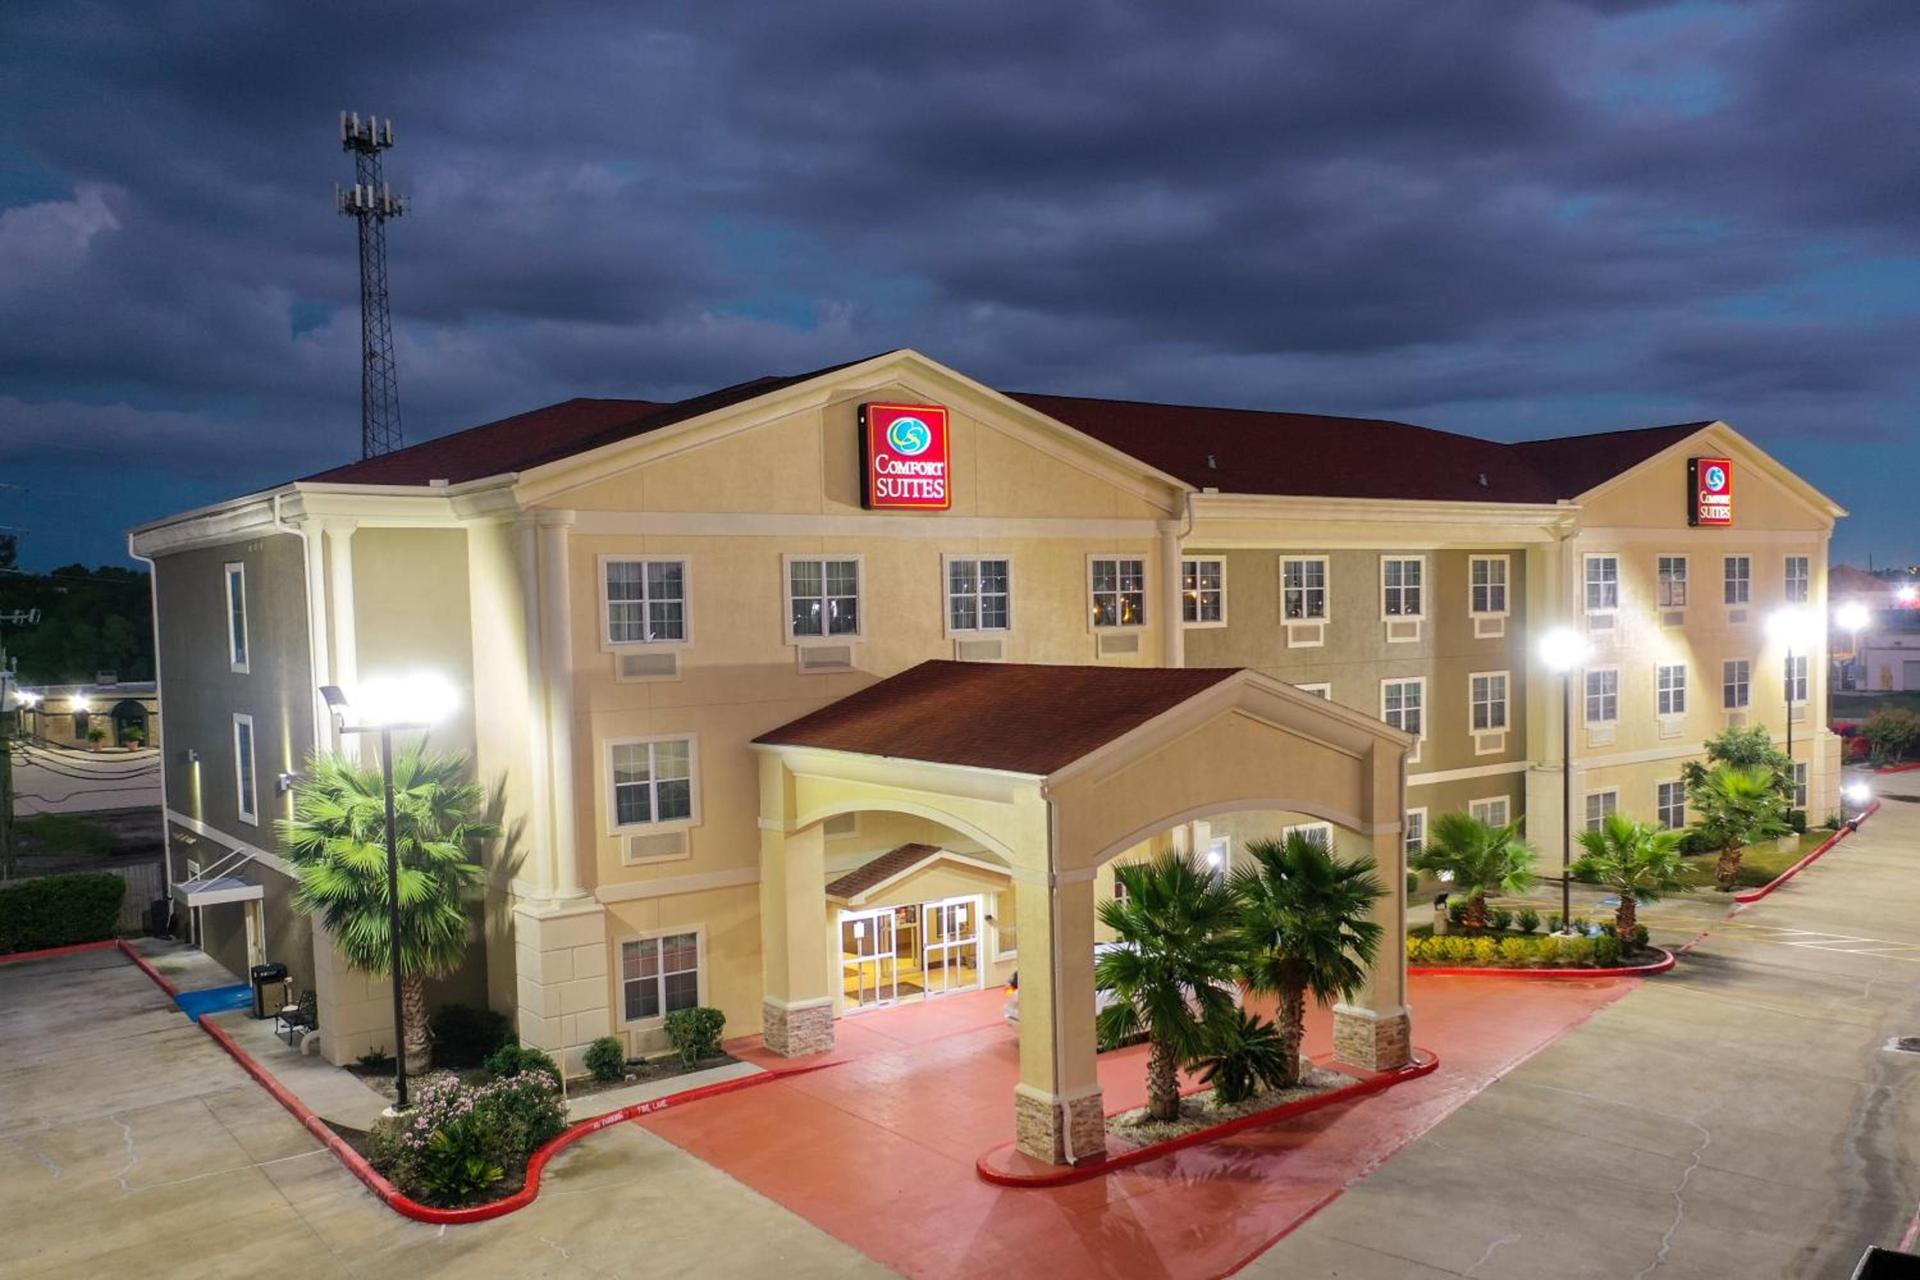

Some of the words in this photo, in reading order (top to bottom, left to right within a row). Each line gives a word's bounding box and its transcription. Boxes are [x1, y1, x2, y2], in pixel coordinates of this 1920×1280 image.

[875, 454, 944, 476] COMFORT
[876, 478, 944, 499] SUITES
[1700, 505, 1731, 519] SUITES
